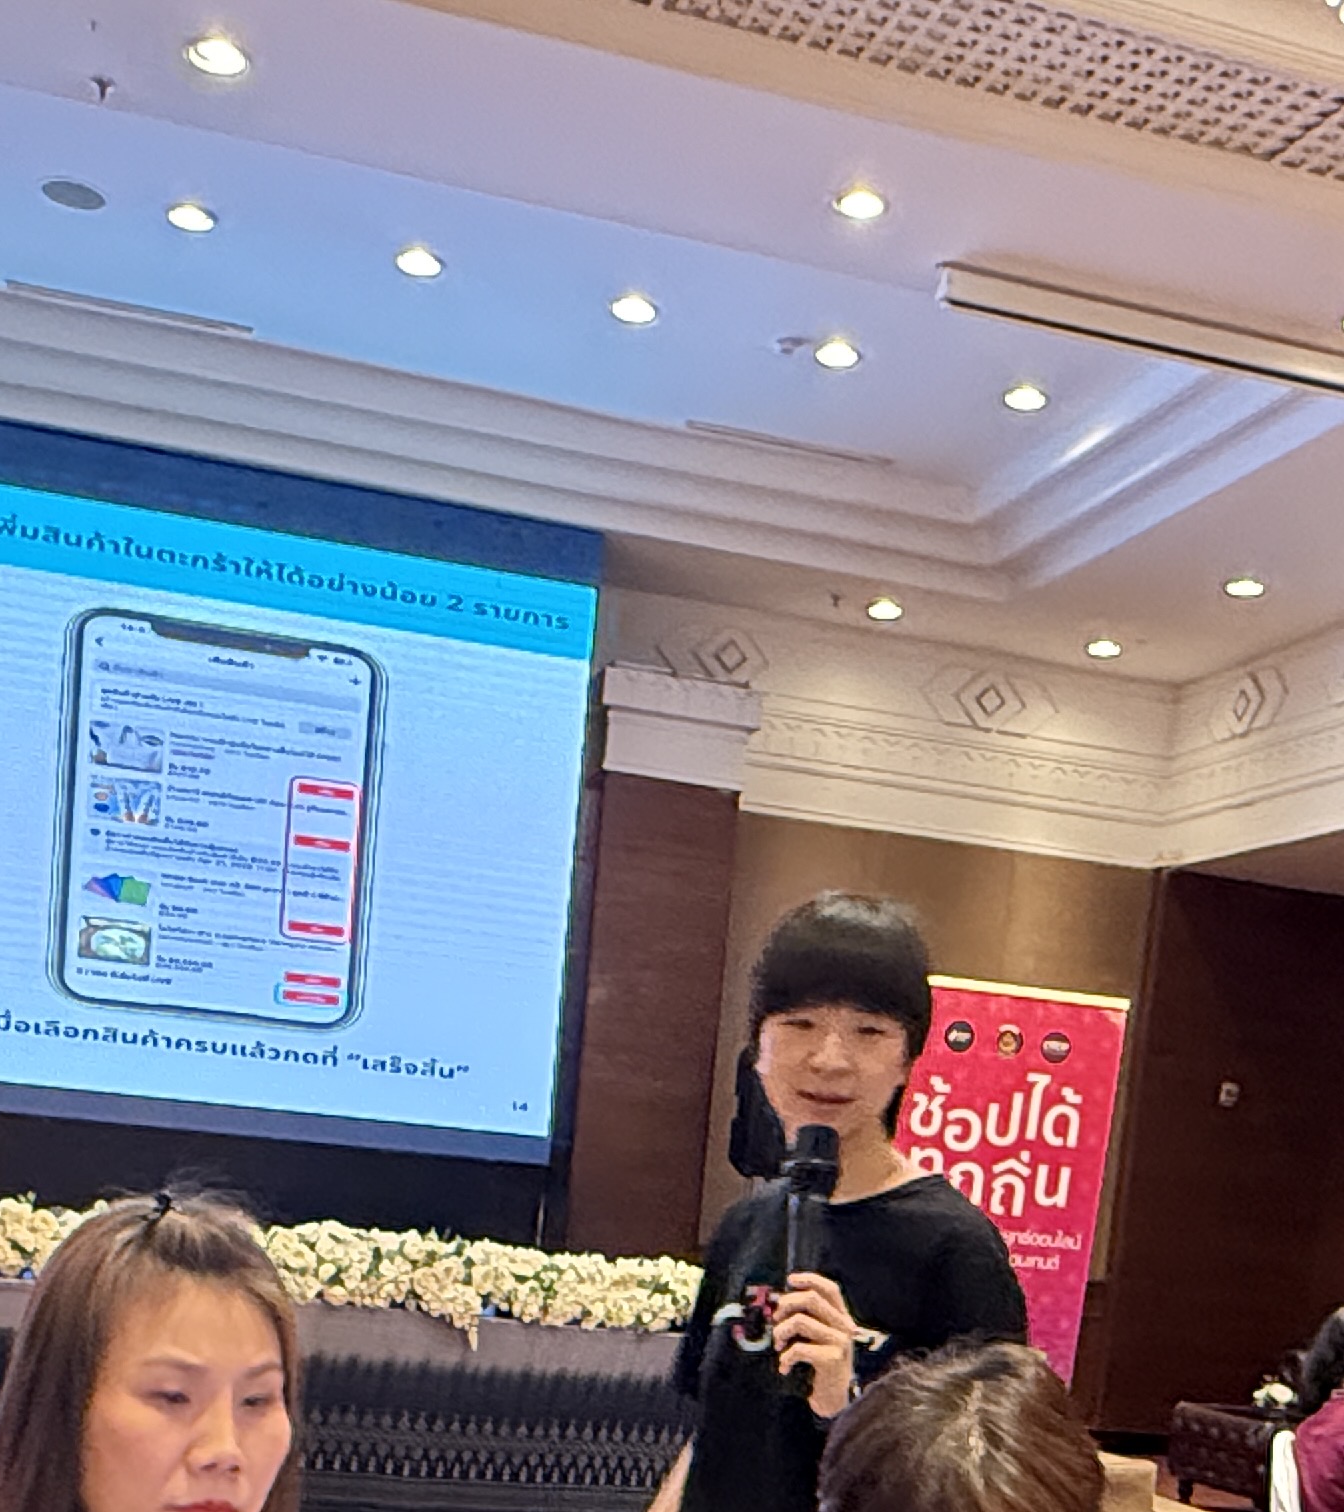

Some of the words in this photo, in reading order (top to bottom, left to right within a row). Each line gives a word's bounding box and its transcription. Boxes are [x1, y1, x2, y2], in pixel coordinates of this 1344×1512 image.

[447, 593, 464, 612] 2
[473, 603, 570, 630] รายการ
[910, 1072, 1083, 1152] ช้อปได้
[910, 1146, 1072, 1217] ทกถิ่น
